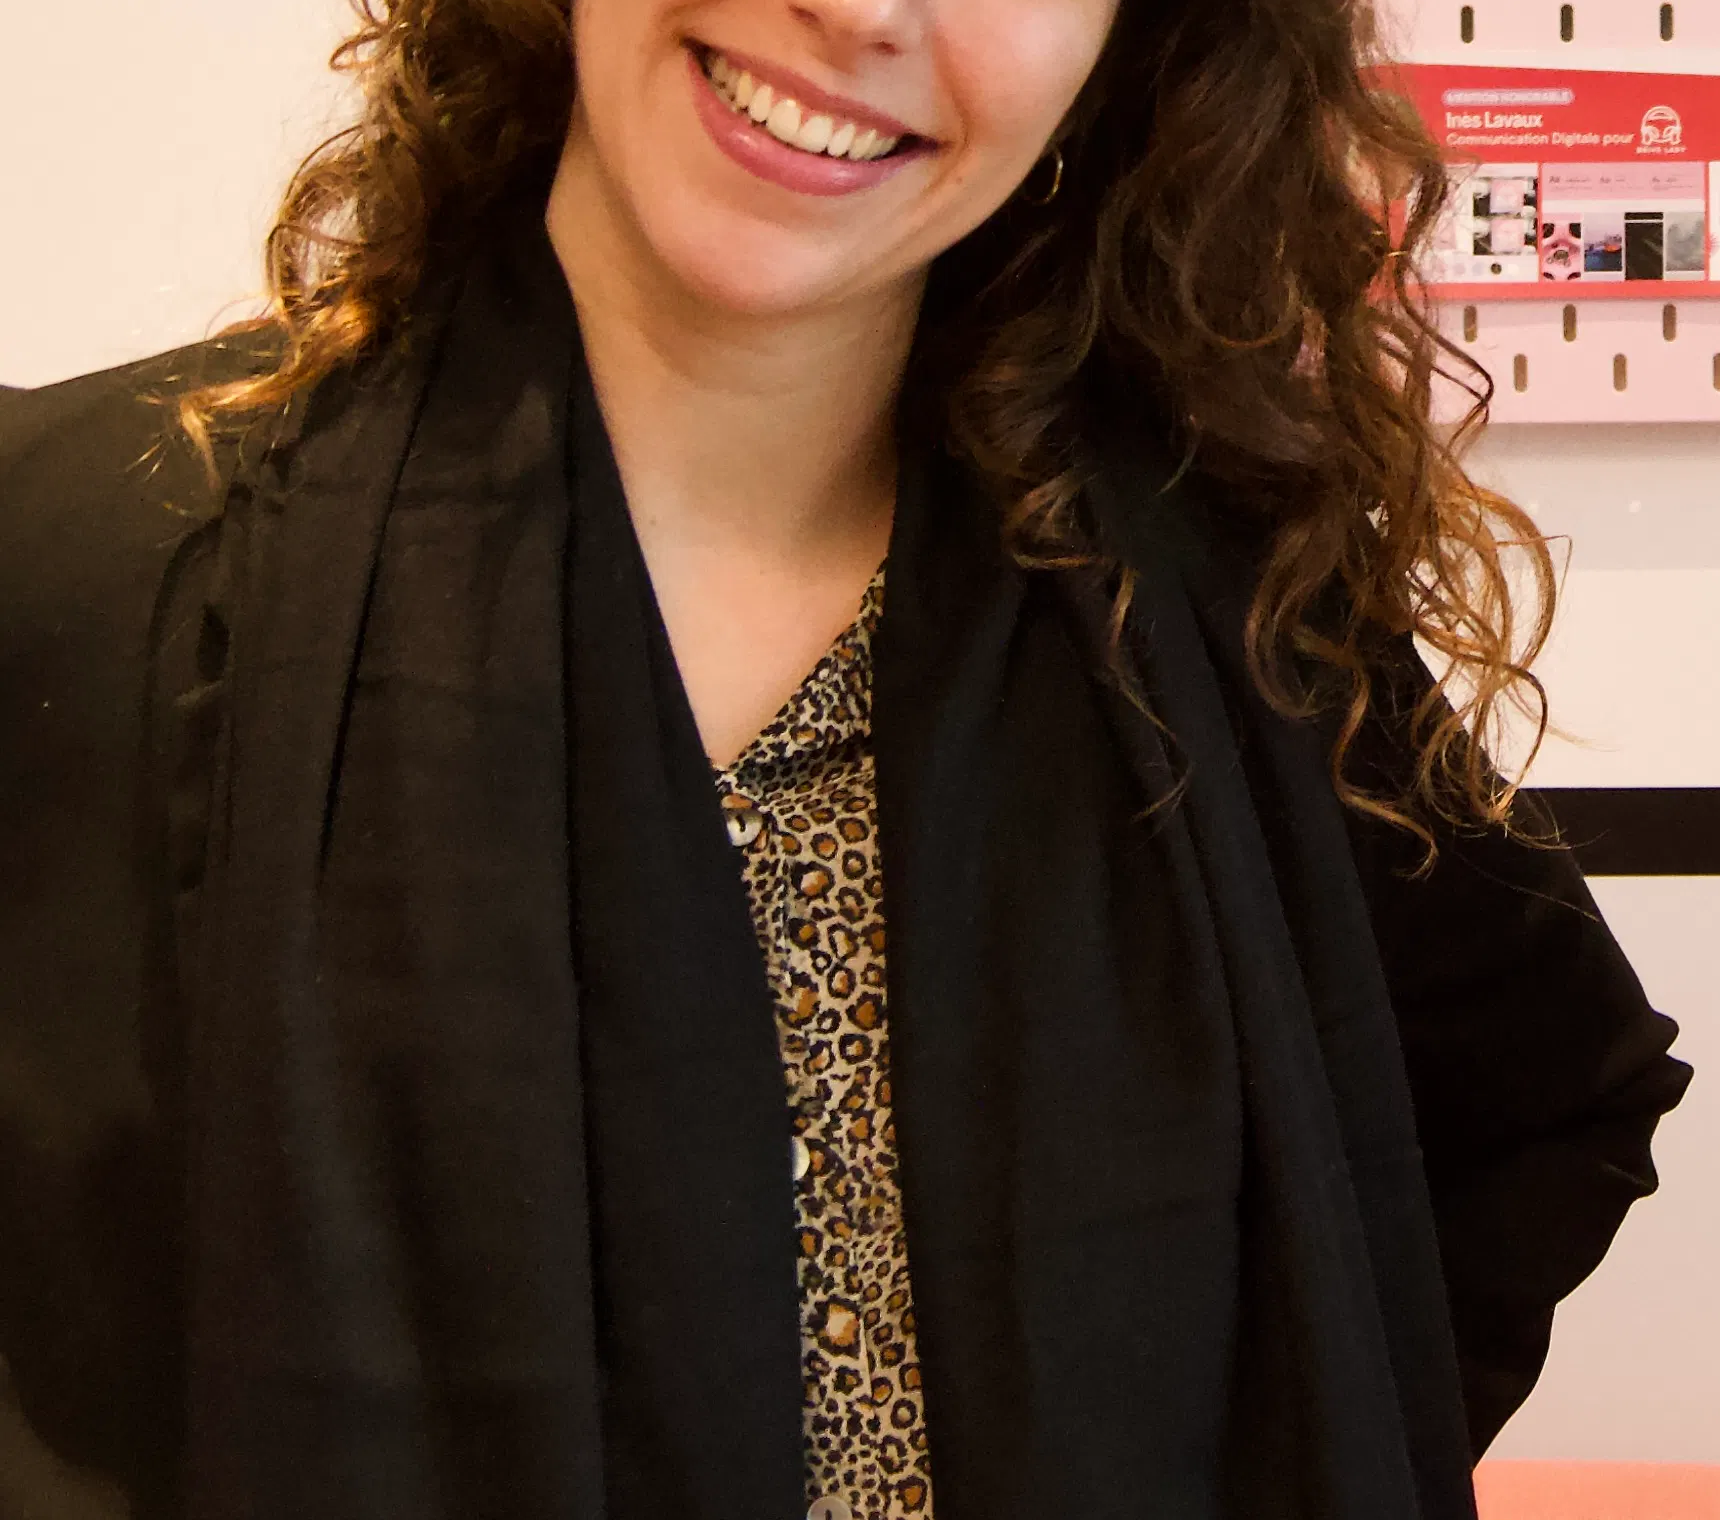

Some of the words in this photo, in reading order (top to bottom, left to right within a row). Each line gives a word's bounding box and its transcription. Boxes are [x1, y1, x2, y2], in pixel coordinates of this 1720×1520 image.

[1485, 111, 1543, 129] Lavaux
[1446, 132, 1549, 146] Communication
[1551, 131, 1600, 147] Digitale
[1602, 134, 1635, 146] pour
